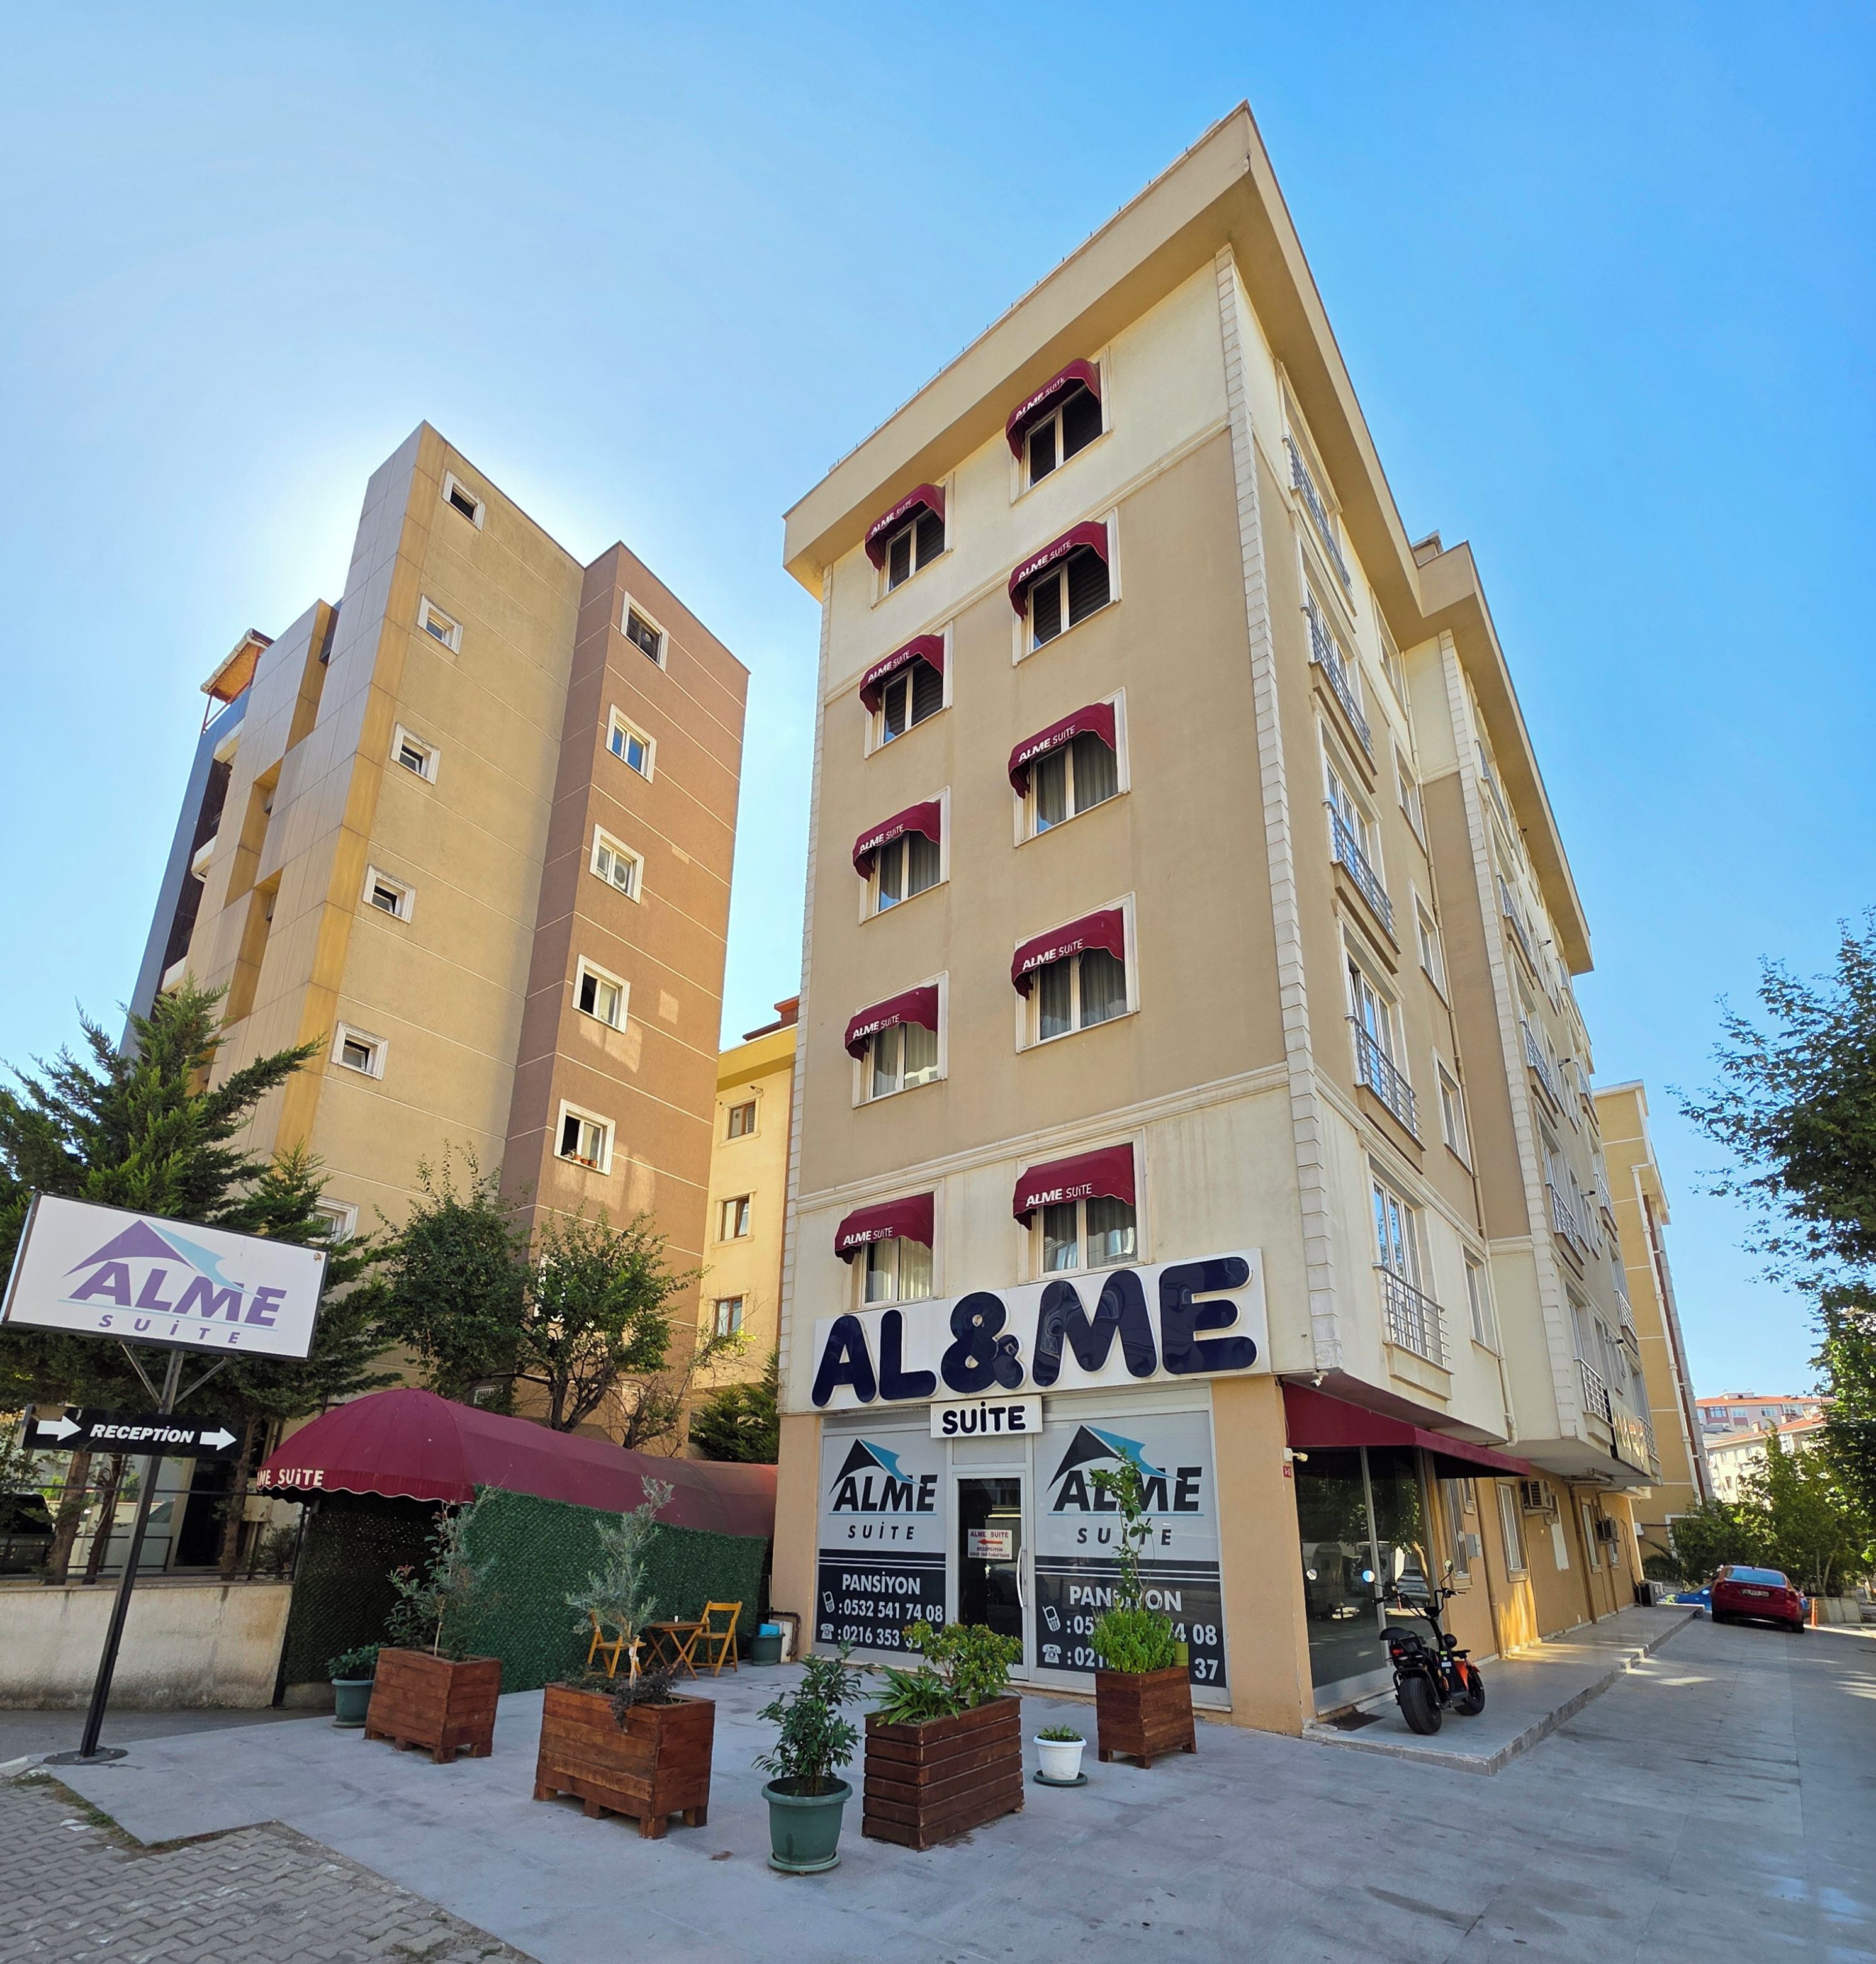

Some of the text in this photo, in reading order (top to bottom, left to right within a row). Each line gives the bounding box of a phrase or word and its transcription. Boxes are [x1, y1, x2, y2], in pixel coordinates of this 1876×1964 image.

[1018, 738, 1051, 762] ALME
[859, 834, 884, 854] ALME
[1022, 948, 1057, 971] ALME
[853, 1021, 880, 1039] ALME
[1025, 1188, 1062, 1207] ALME
[843, 1230, 872, 1246] ALME
[68, 1260, 287, 1327] ALME
[811, 1256, 1259, 1407] AL&ME
[833, 1474, 938, 1512] ALME
[877, 1601, 900, 1619] 541
[906, 1603, 922, 1620] 74
[926, 1605, 943, 1622] 08
[877, 1628, 900, 1647] 353
[1193, 1624, 1217, 1646] 08
[1194, 1658, 1218, 1680] 37
